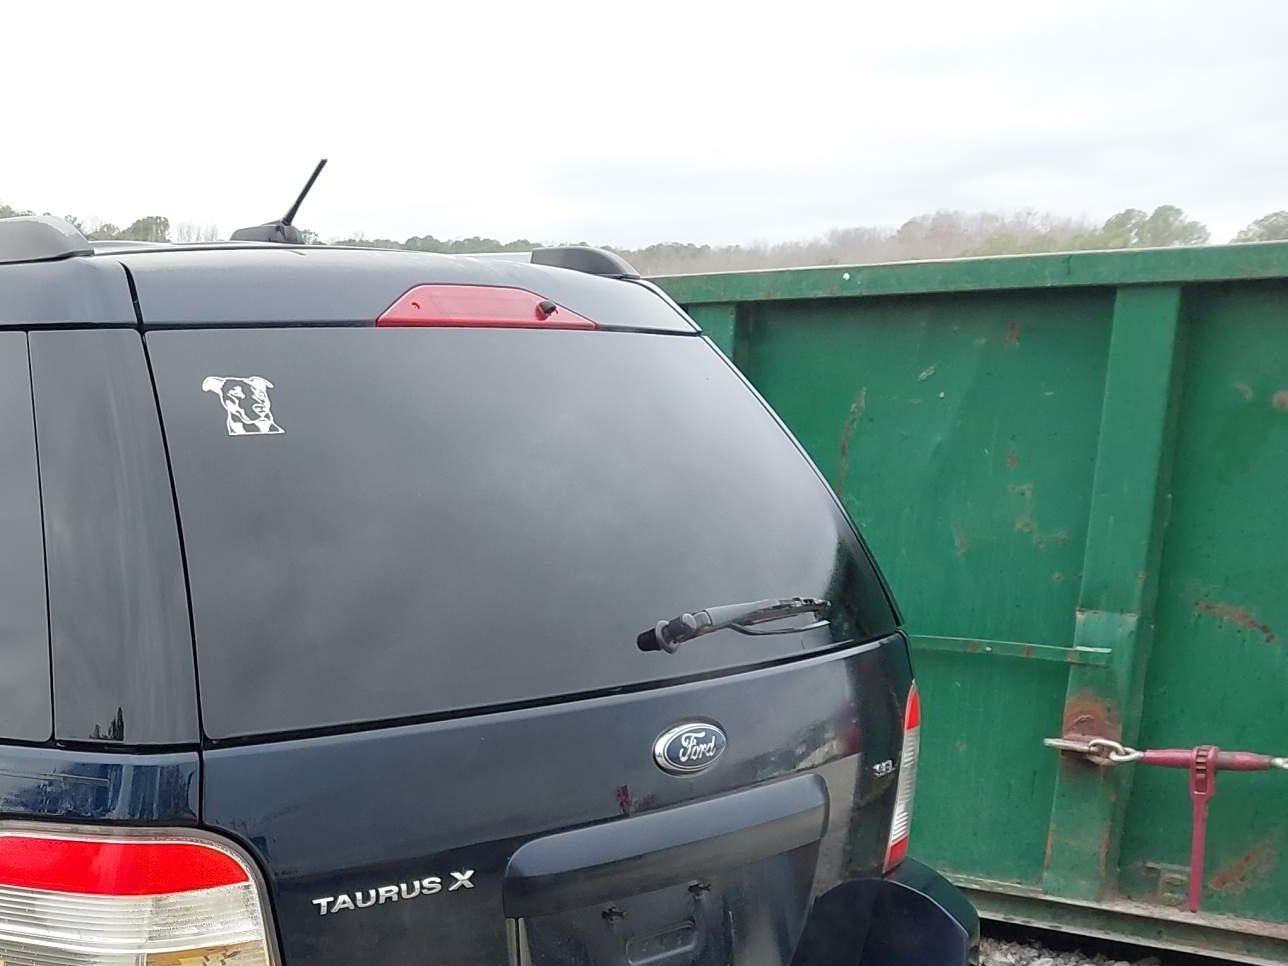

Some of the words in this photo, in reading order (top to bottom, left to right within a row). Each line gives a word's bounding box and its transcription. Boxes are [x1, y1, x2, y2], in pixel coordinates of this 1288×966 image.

[679, 731, 716, 762] Ford
[312, 877, 442, 915] TAURUS
[448, 869, 475, 891] X
